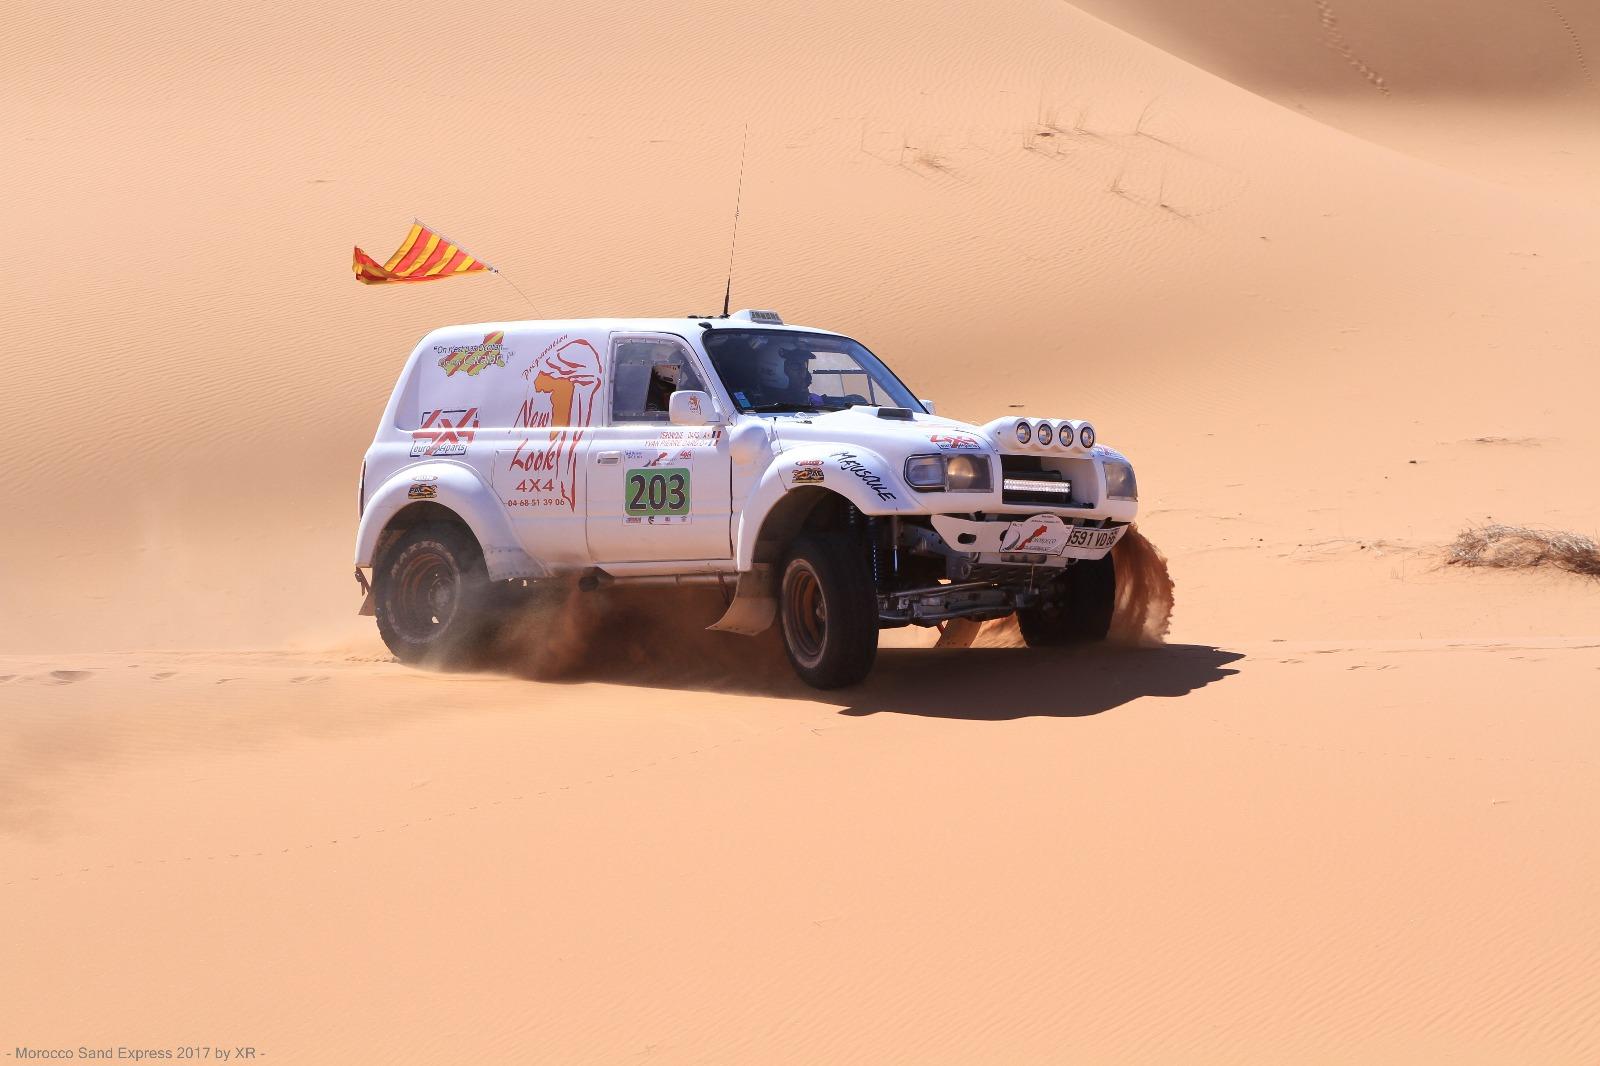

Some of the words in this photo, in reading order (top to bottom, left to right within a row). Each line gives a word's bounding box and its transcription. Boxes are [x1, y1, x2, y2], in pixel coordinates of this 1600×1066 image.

[508, 397, 550, 434] New
[509, 438, 557, 472] Look
[515, 478, 554, 492] 4X4
[629, 473, 686, 510] 203
[829, 451, 897, 501] MAJUSCULE
